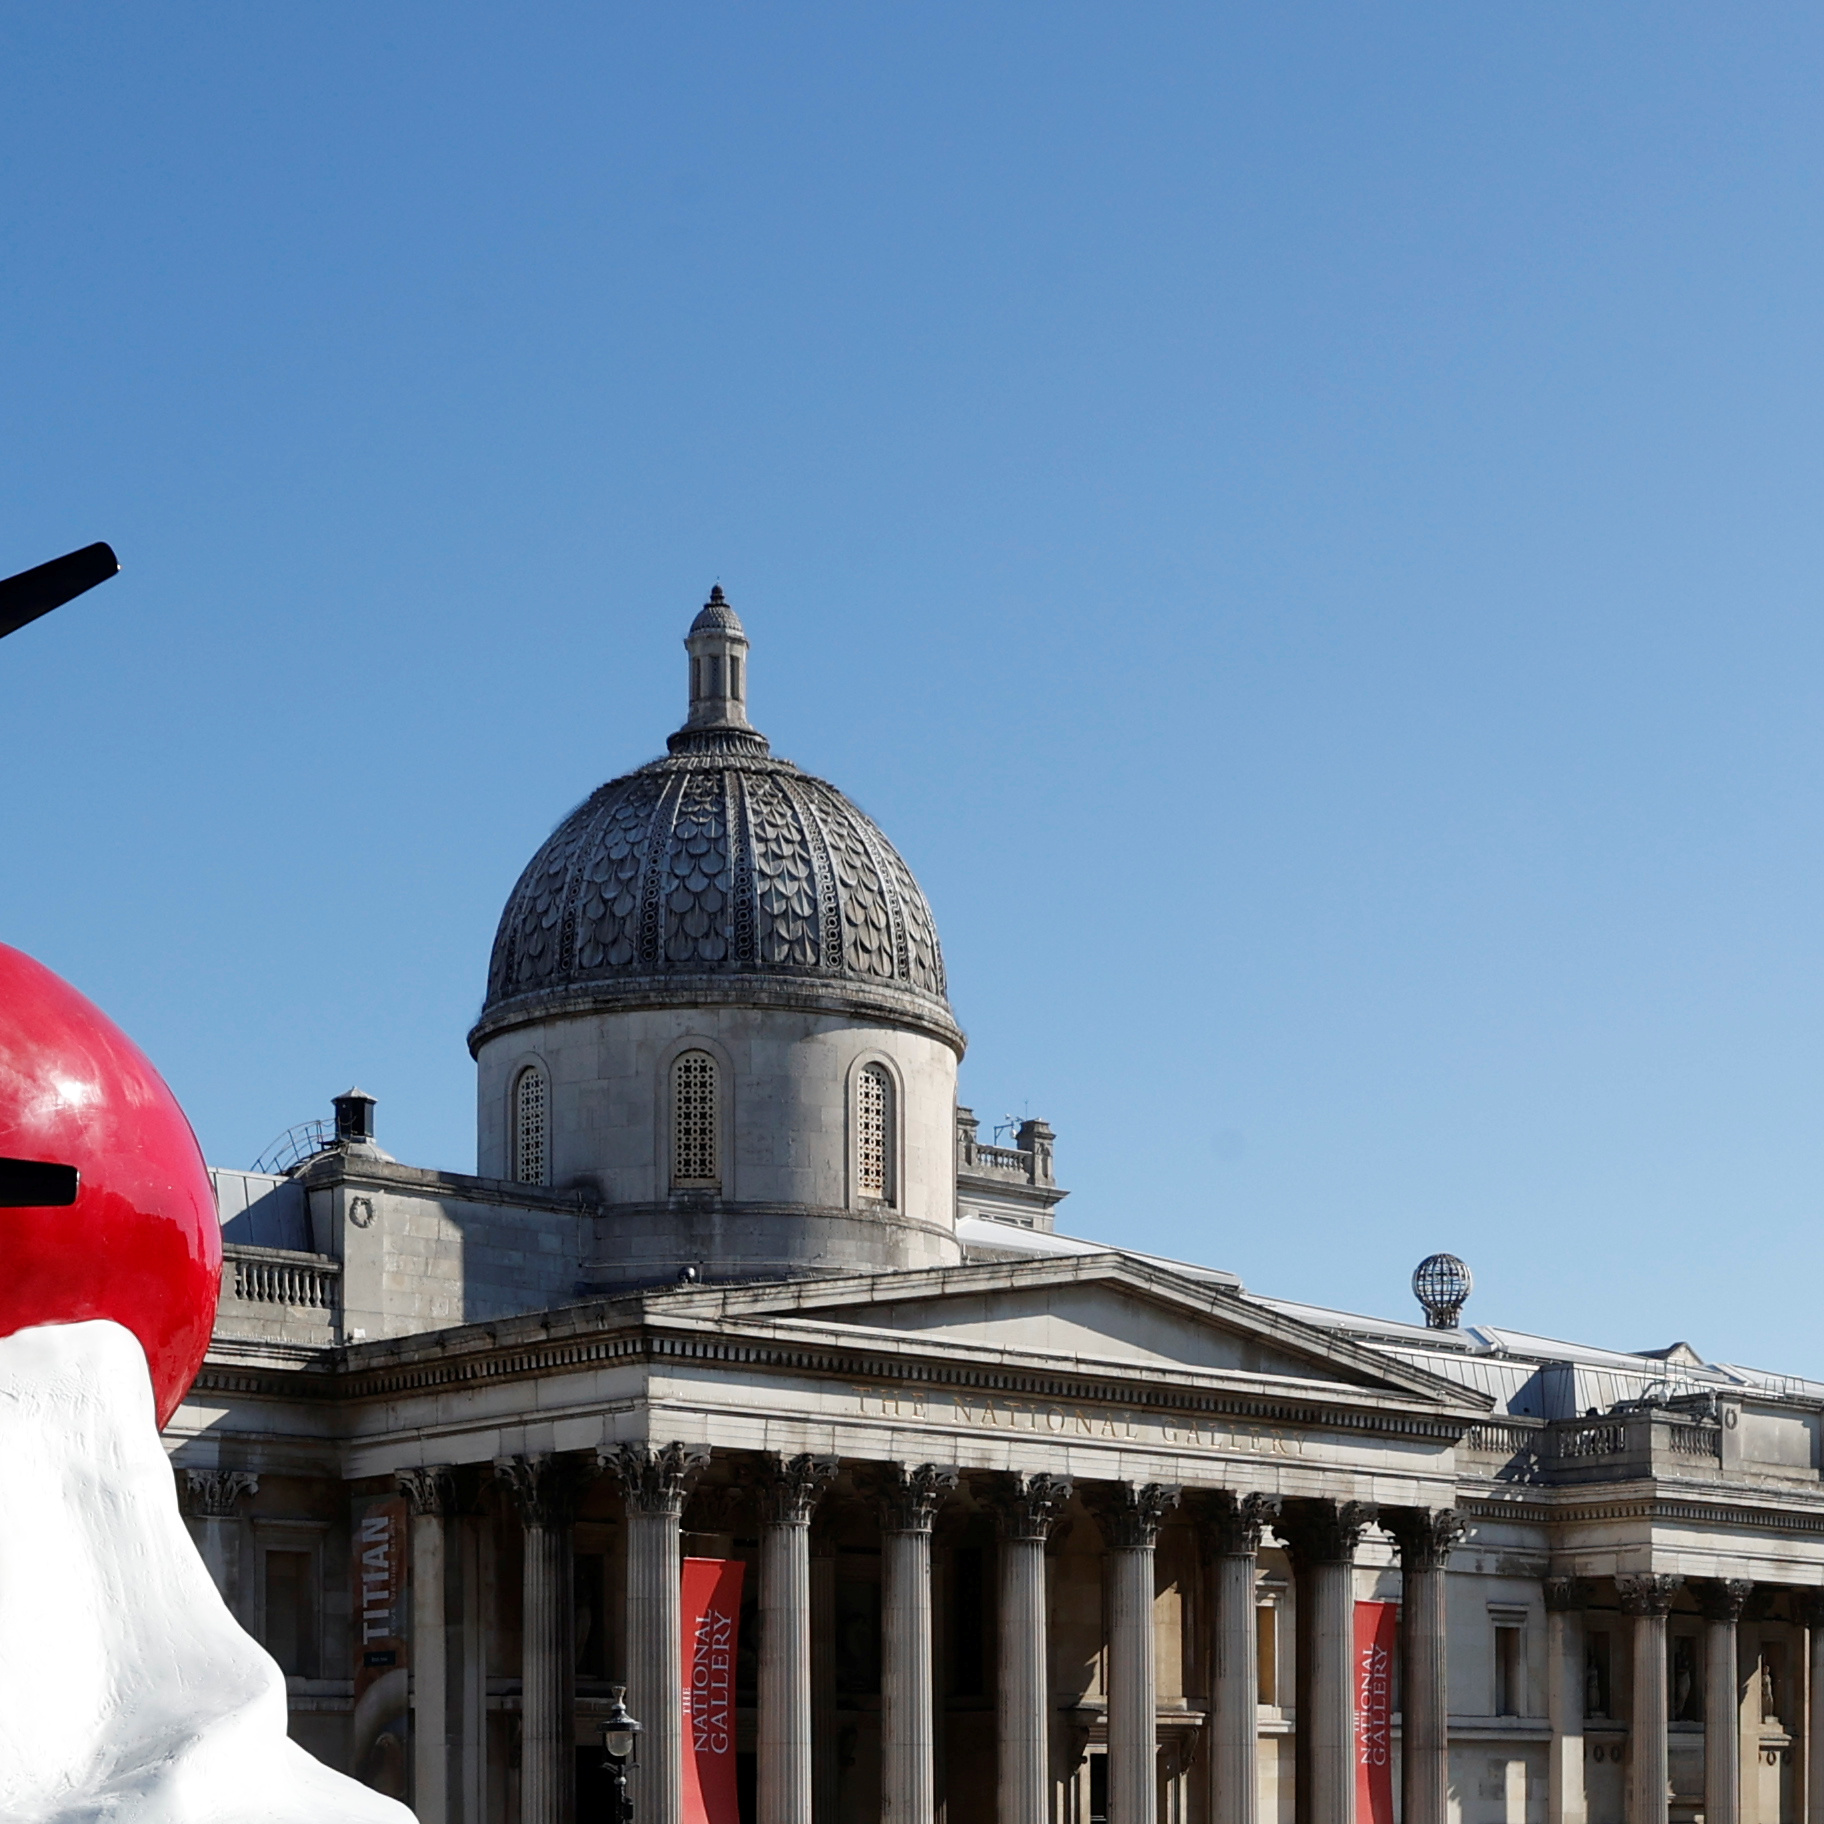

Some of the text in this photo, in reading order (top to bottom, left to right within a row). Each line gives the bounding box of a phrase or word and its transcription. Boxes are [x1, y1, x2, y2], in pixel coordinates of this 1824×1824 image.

[361, 1516, 390, 1645] TITIAN
[682, 1687, 691, 1716] THE
[692, 1608, 712, 1753] NATIONAL
[710, 1609, 732, 1755] GALLERY
[1360, 1642, 1375, 1764] NATIONAL
[1372, 1643, 1388, 1766] GALLERY
